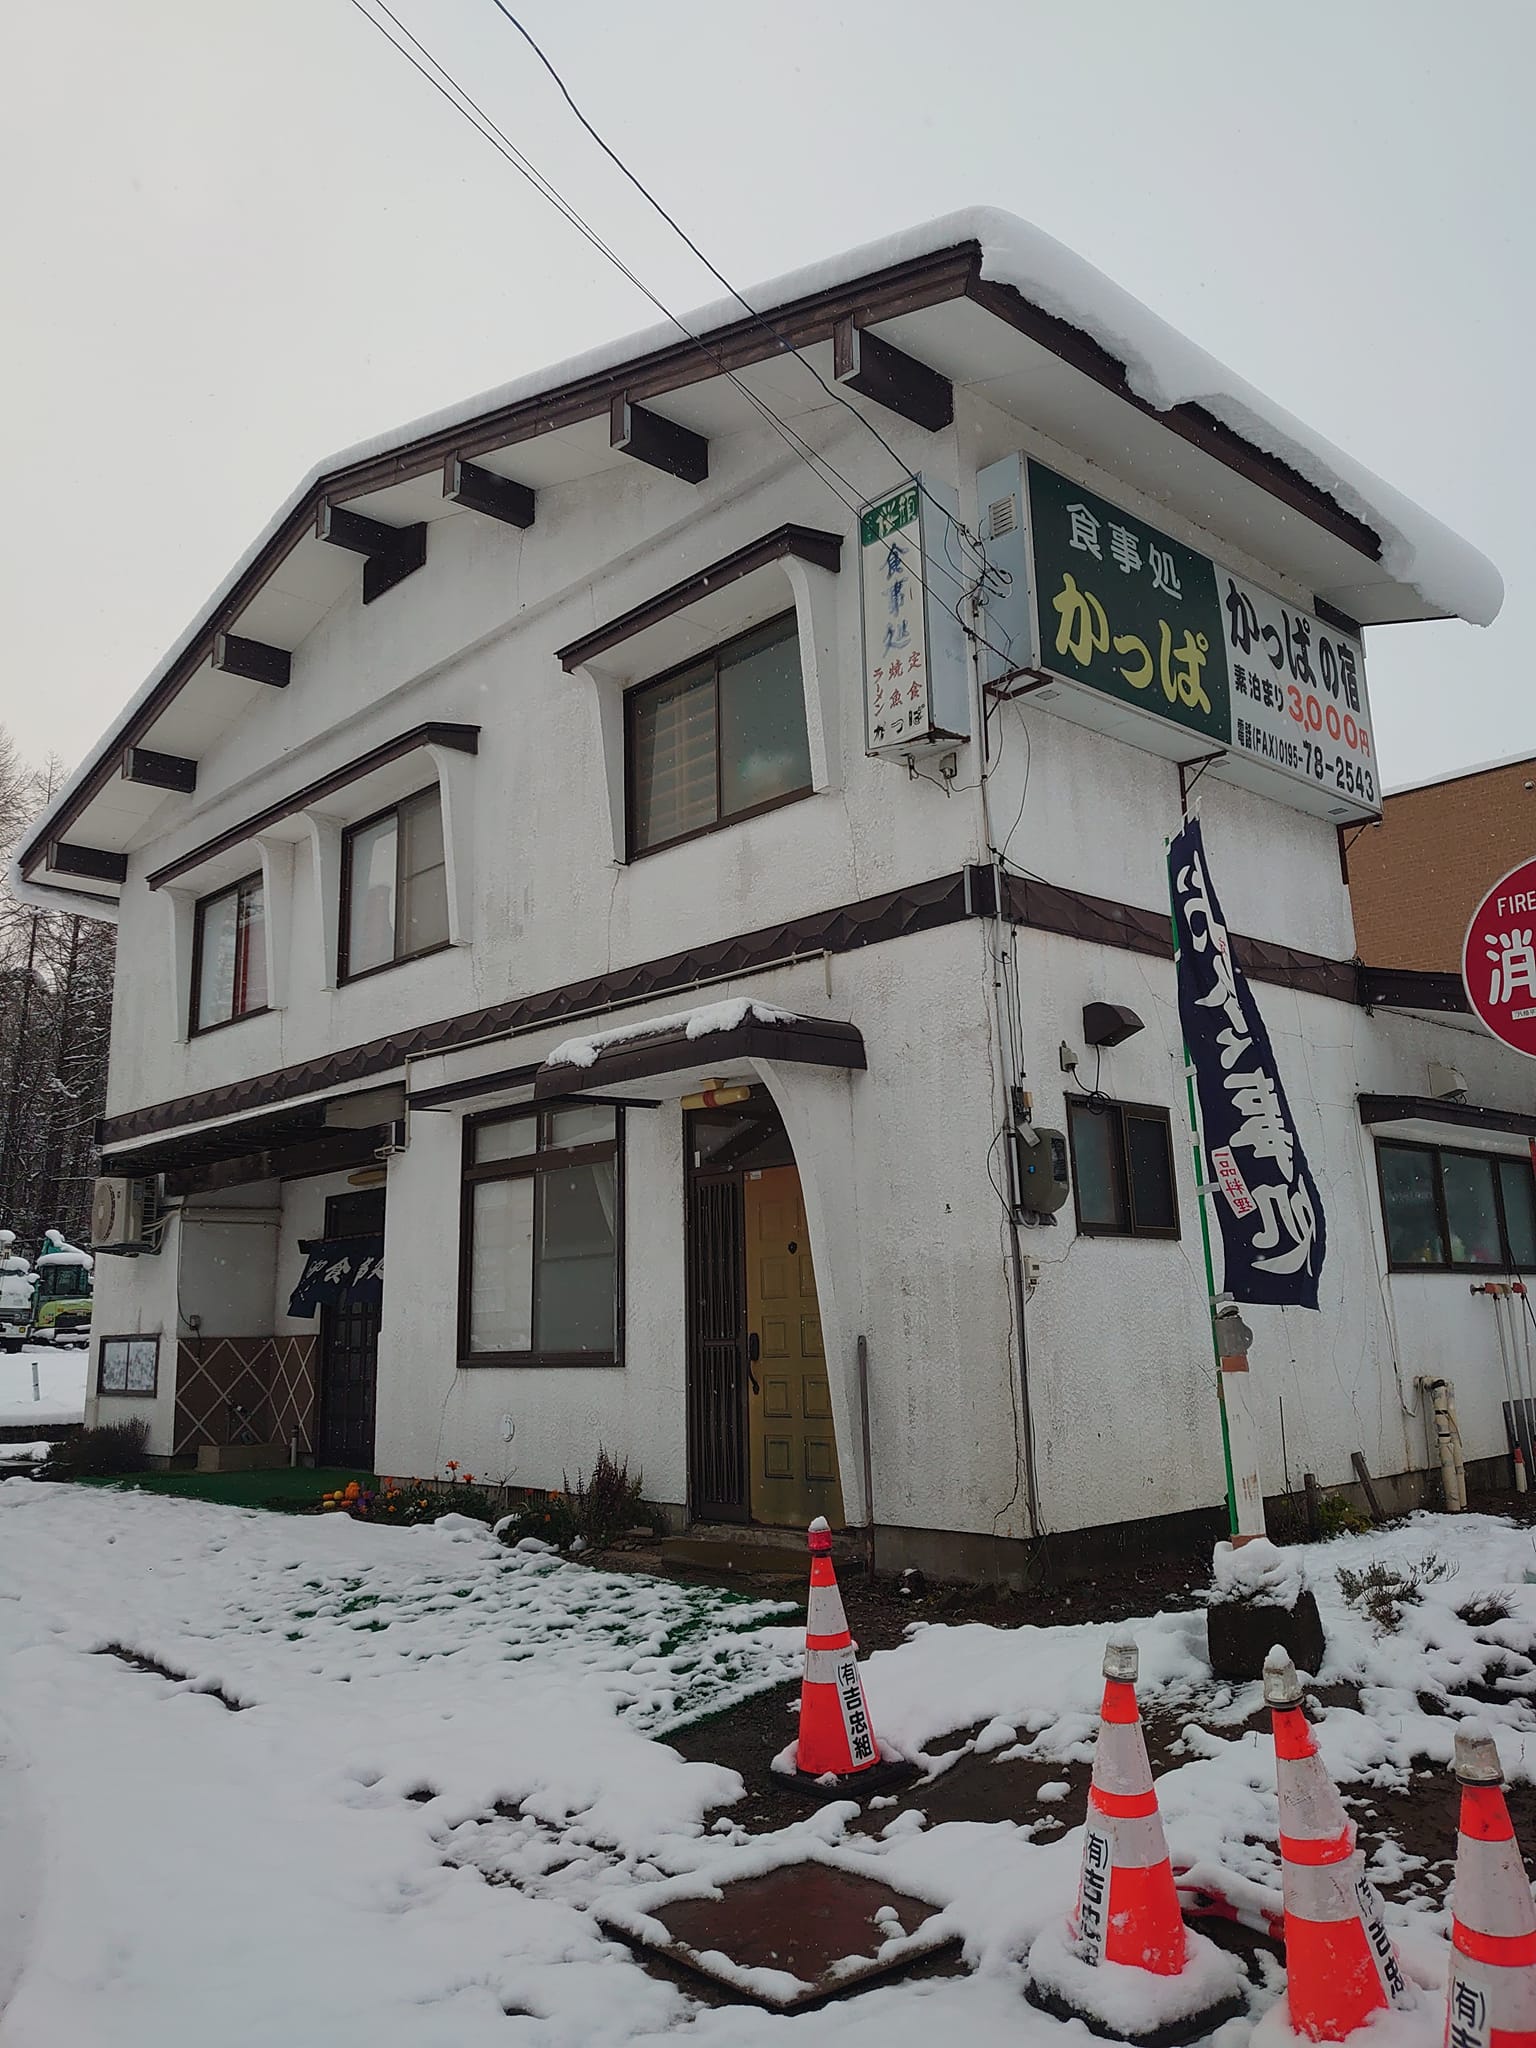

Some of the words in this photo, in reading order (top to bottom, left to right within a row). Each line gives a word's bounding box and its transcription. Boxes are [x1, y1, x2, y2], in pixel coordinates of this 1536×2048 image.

[1066, 502, 1182, 600] 食事処
[880, 542, 911, 659] 食事処
[1052, 572, 1211, 714] かっぱ
[888, 658, 904, 710] 焼魚
[906, 650, 923, 701] 定食
[1226, 578, 1361, 714] かっぱの宿
[873, 667, 884, 718] ラーメン
[873, 703, 926, 742] かっぱ
[1234, 663, 1284, 713] 素泊まり
[1287, 684, 1370, 758] 3,000円
[1498, 891, 1536, 917] FIRE
[1485, 929, 1536, 1005] 消
[838, 1662, 873, 1761] (有)吉忠組
